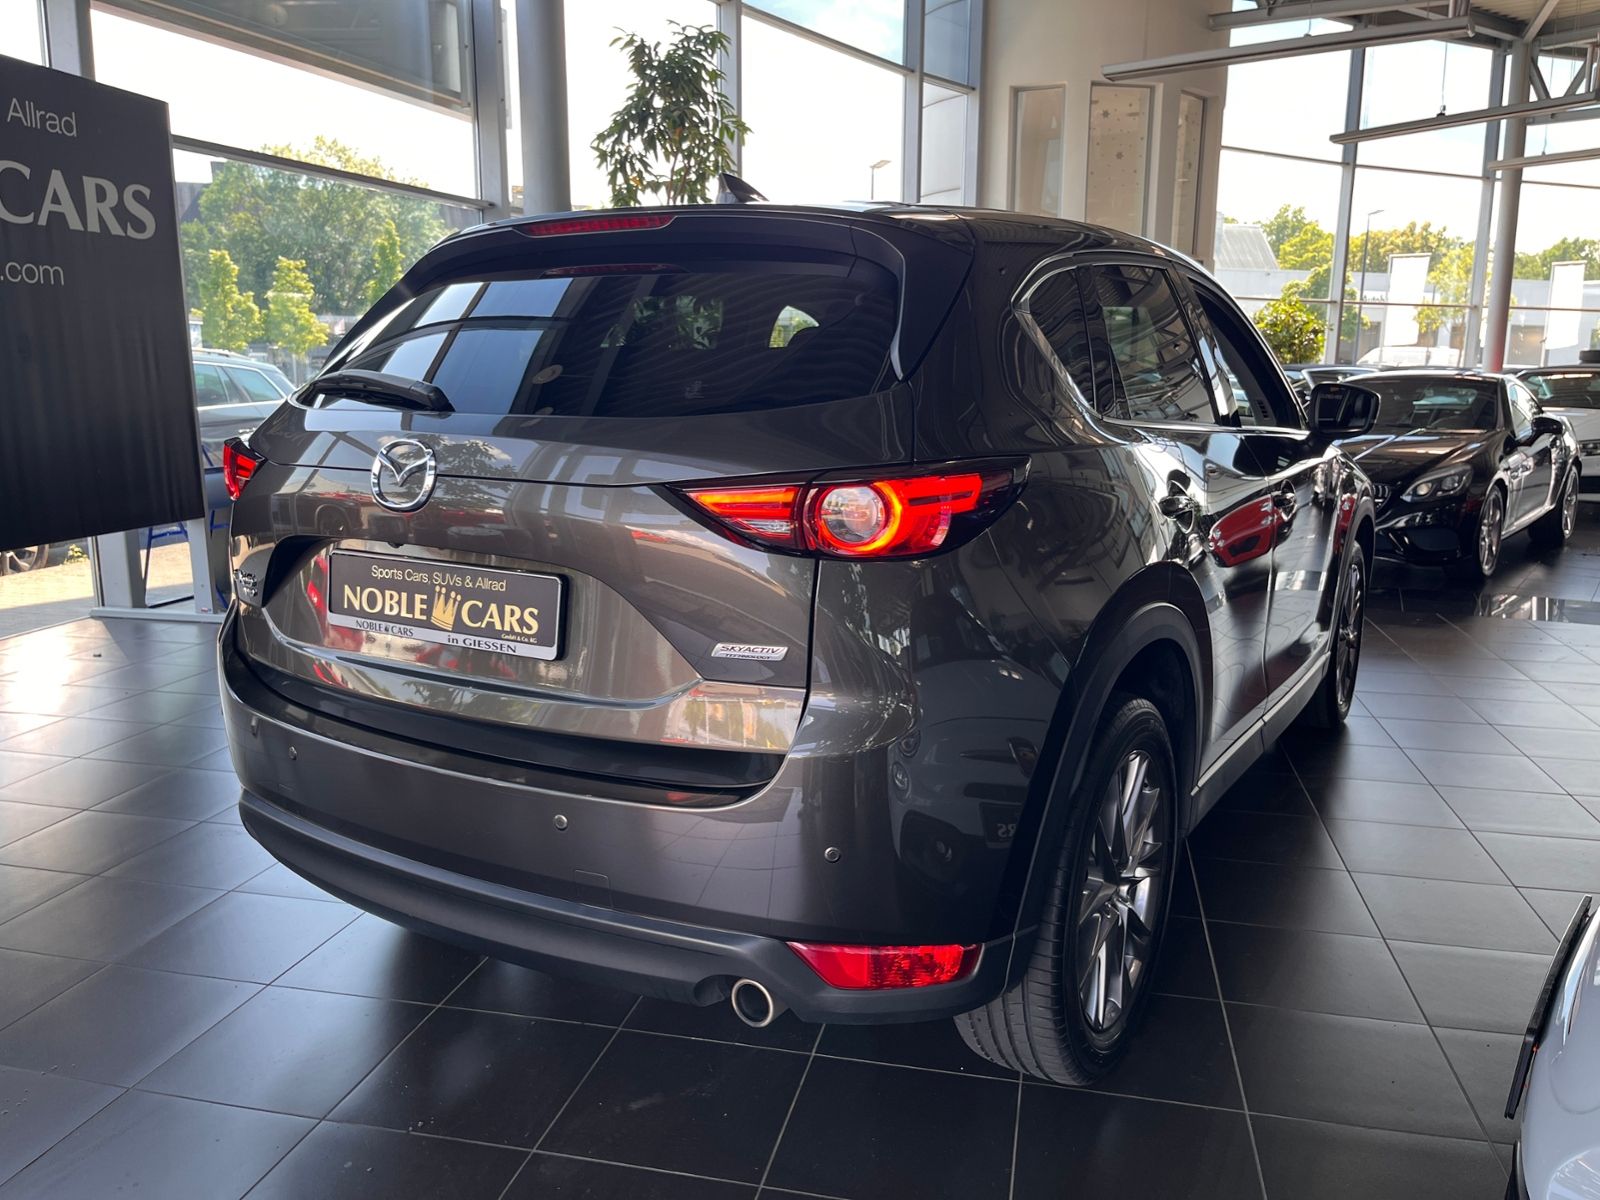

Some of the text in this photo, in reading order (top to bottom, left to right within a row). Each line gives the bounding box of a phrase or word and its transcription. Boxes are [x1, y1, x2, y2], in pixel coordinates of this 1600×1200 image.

[7, 97, 78, 138] Allrad
[0, 159, 156, 240] CARS
[371, 565, 507, 592] Sports Cars, SUVs & Allrad
[343, 584, 539, 635] NOBLE CARS
[355, 619, 414, 637] NOBLE CARS
[447, 634, 517, 654] in GIESSEN
[720, 645, 781, 654] SKYACTIV
